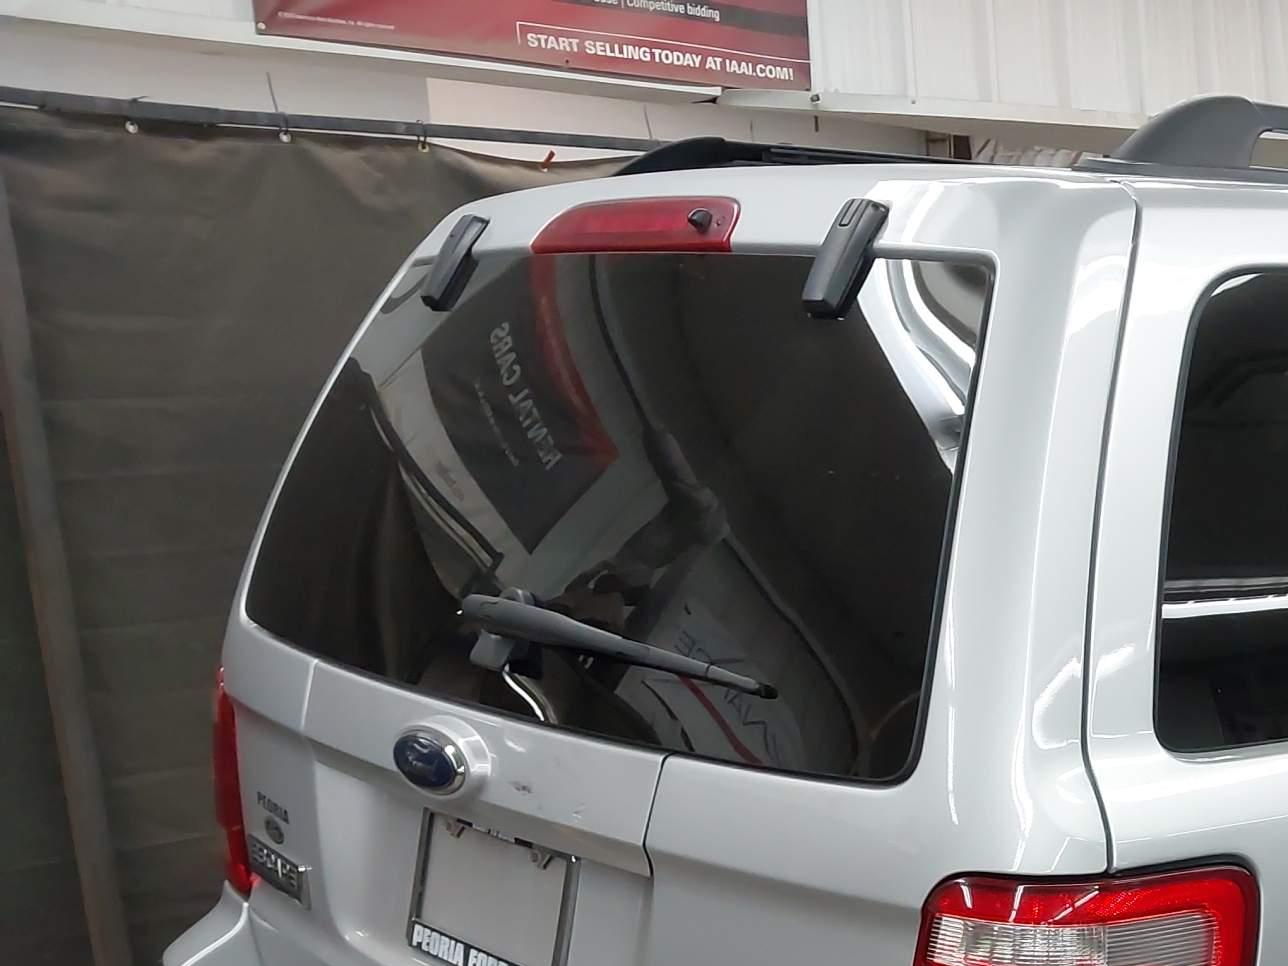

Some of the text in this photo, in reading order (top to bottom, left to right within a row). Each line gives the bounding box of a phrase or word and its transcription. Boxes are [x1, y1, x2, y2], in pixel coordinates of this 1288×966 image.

[627, 0, 686, 14] Competitive
[687, 3, 720, 21] bidding
[527, 32, 794, 80] START SELLING TODAY AT IAAI.COM!
